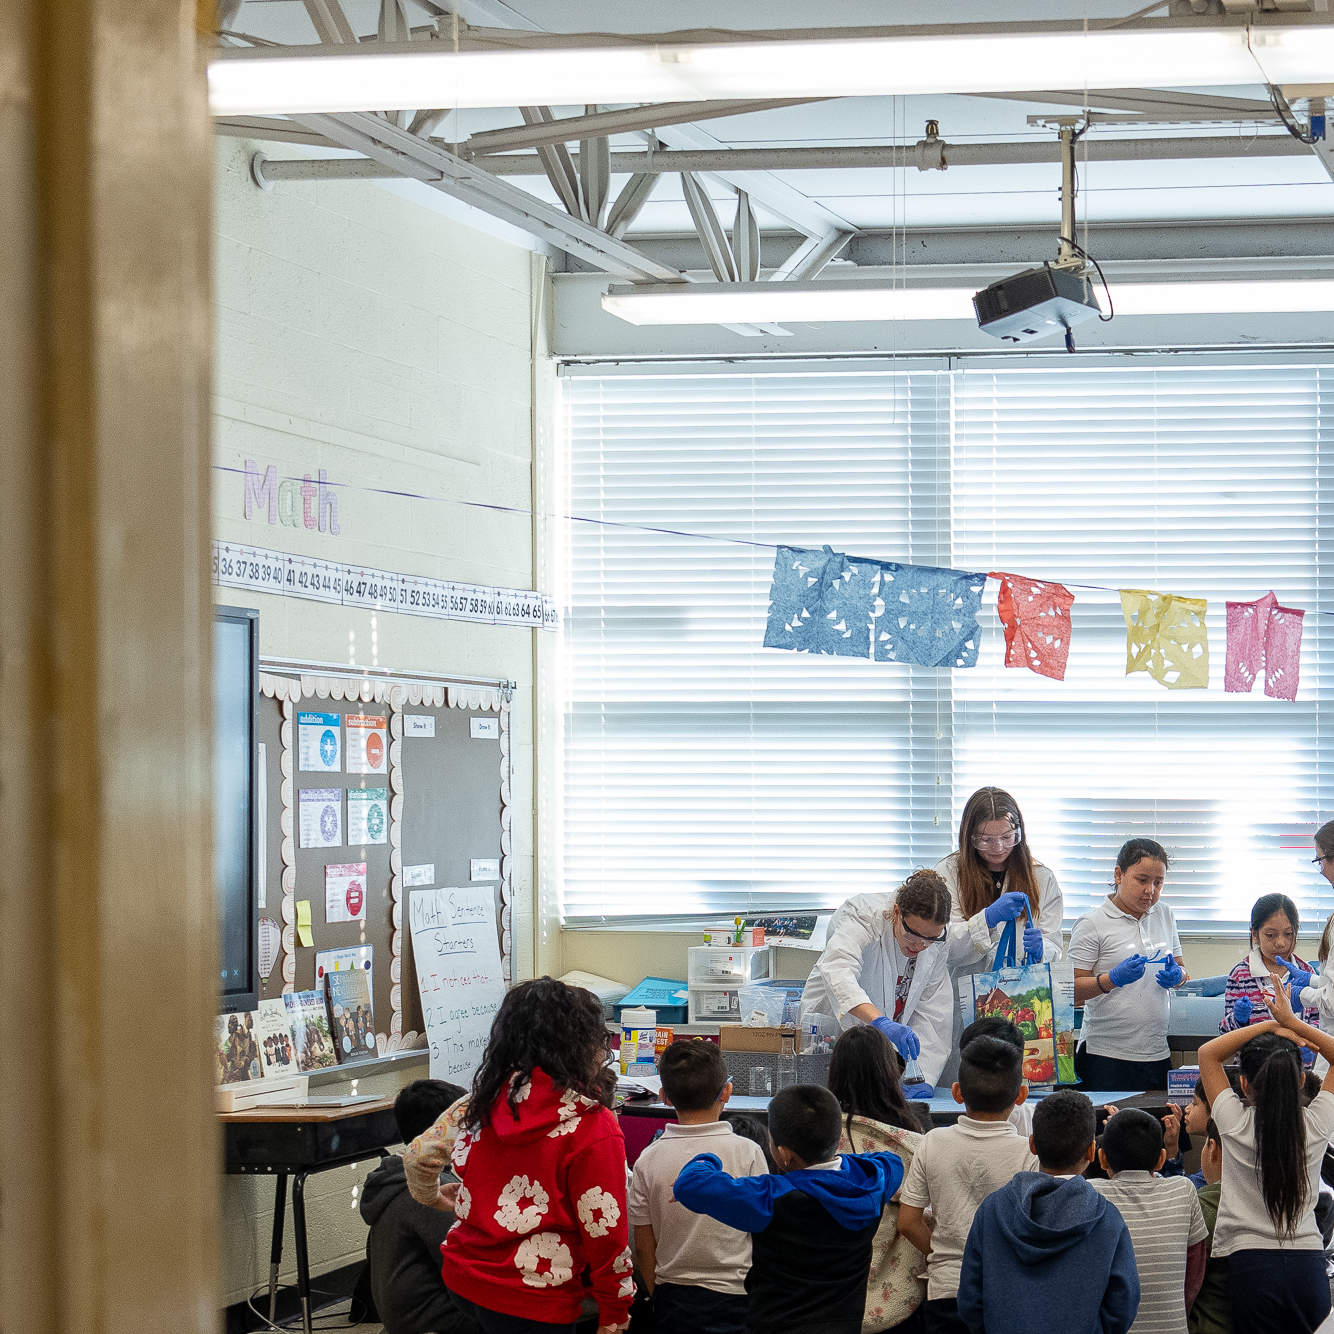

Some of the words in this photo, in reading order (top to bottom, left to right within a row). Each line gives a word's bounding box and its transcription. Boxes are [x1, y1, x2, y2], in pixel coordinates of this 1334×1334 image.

[244, 460, 340, 536] Math
[221, 558, 234, 576] 36
[236, 560, 247, 578] 37
[249, 562, 260, 580] 38
[262, 564, 271, 582] 39
[273, 566, 282, 584] 40
[286, 569, 296, 586] 41
[298, 571, 309, 588] 42
[310, 573, 321, 591] 43
[322, 575, 332, 592] 44
[333, 577, 342, 594] 45
[344, 579, 354, 596] 46
[356, 581, 367, 598] 47
[368, 583, 378, 599] 48
[379, 585, 388, 601] 49
[388, 587, 397, 602] 50
[400, 589, 408, 604] 51
[410, 590, 420, 606] 52
[422, 591, 431, 607] 53
[431, 593, 439, 608] 54
[441, 594, 448, 610] 55
[450, 595, 459, 611] 56
[459, 597, 468, 612] 57
[469, 598, 478, 613] 58
[480, 600, 487, 614] 59
[488, 601, 494, 615] 60
[496, 601, 503, 615] 61
[505, 602, 512, 616] 62
[512, 603, 519, 617] 63
[521, 604, 530, 617] 64
[532, 604, 542, 619] 65
[544, 609, 550, 622] 66
[300, 715, 324, 724] addition
[348, 717, 376, 727] subtraction
[413, 898, 445, 927] Math
[449, 893, 484, 919] Sentence
[434, 931, 474, 952] Starters
[430, 973, 440, 991] I
[443, 969, 471, 987] noticed
[437, 1006, 447, 1025] I
[450, 1008, 469, 1033] agree
[470, 1000, 498, 1016] because
[444, 1036, 464, 1054] This
